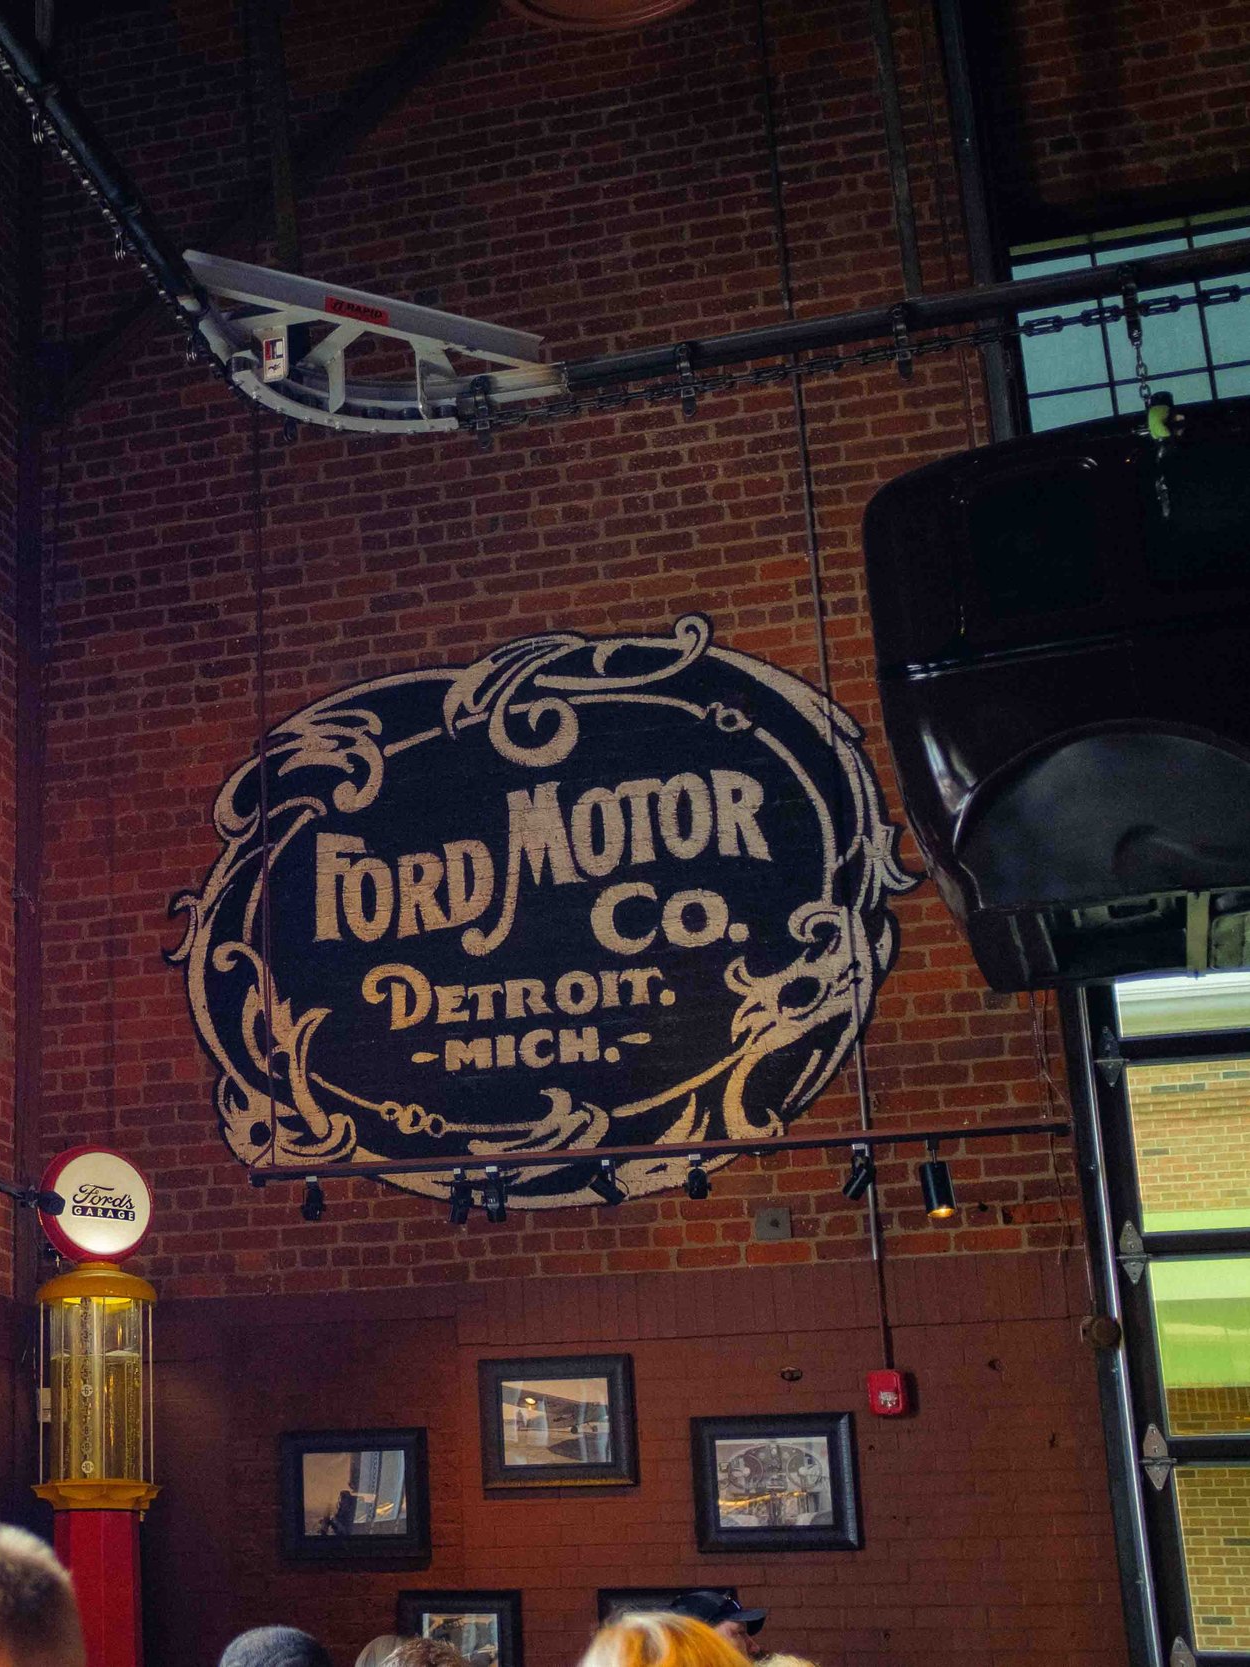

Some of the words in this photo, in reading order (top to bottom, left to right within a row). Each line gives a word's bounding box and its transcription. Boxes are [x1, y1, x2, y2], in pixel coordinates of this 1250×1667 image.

[312, 831, 496, 944] FORD
[461, 769, 772, 957] MOTOR
[590, 881, 750, 955] CO.
[72, 1183, 136, 1210] Ford's
[73, 1206, 135, 1220] GARAGE
